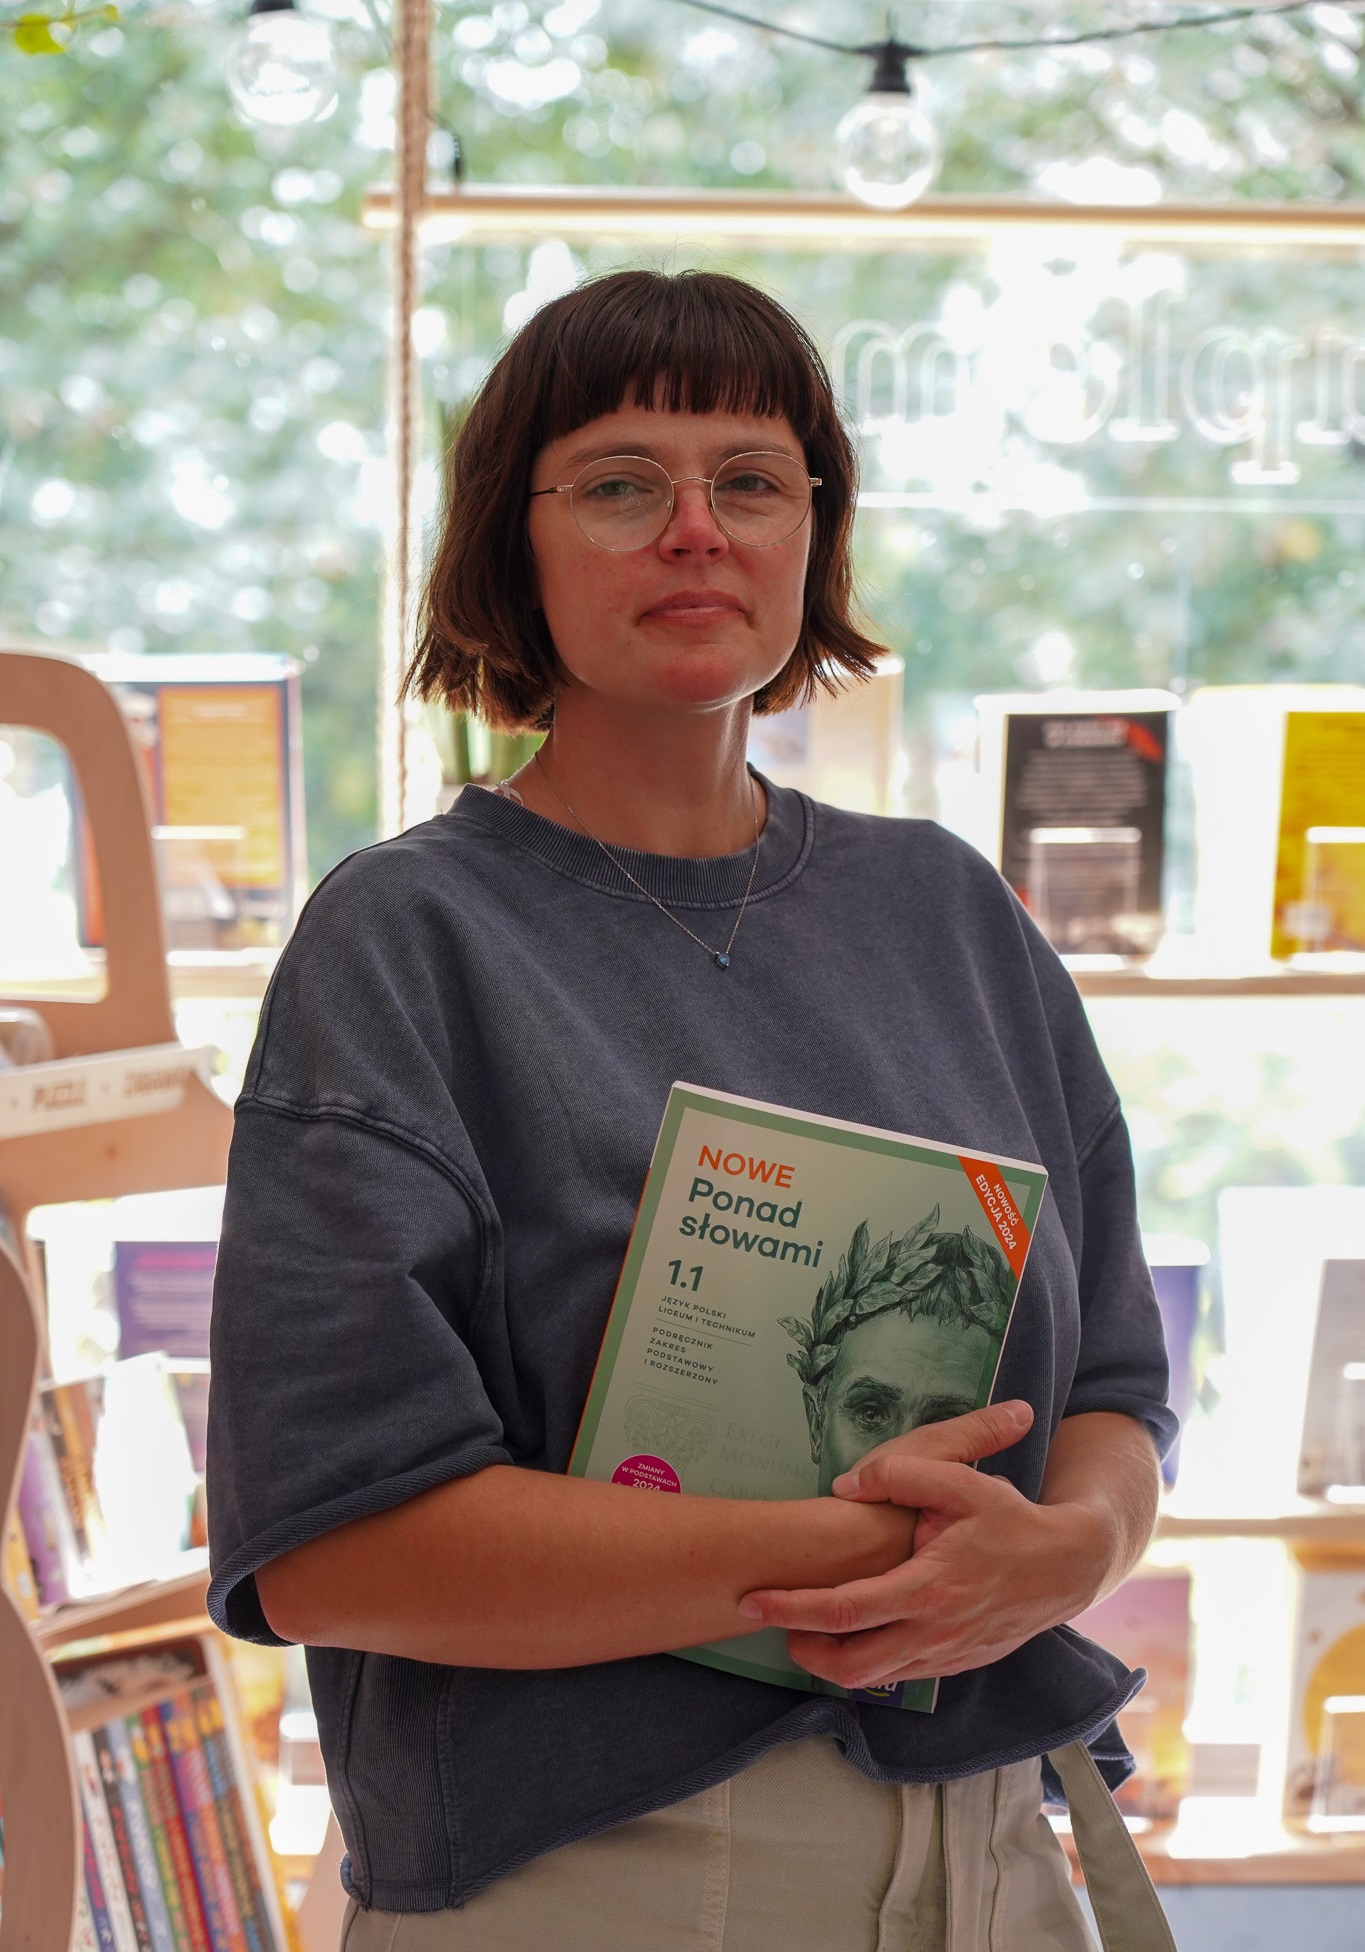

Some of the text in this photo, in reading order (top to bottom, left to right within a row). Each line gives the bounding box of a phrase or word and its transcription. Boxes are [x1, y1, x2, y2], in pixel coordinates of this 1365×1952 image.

[698, 1144, 796, 1189] NOWE
[688, 1177, 803, 1229] Ponad
[975, 1174, 1017, 1250] EDYCJA 2024
[993, 1183, 1019, 1226] NOWOŚĆ
[679, 1212, 824, 1268] słowami
[668, 1259, 704, 1292] 1.1
[661, 1295, 727, 1319] JĘZYK POLSKI
[658, 1306, 693, 1321] LICEUM
[701, 1318, 756, 1338] TECHNIKUM
[649, 1337, 687, 1353] ZAKRES
[652, 1326, 714, 1350] PODRĘCZNIK
[646, 1347, 715, 1373] PODSTAWOWY
[649, 1360, 719, 1385] ROZSZERZONY
[629, 1468, 678, 1488] PODSTAWACH
[637, 1462, 665, 1475] ZMIANY
